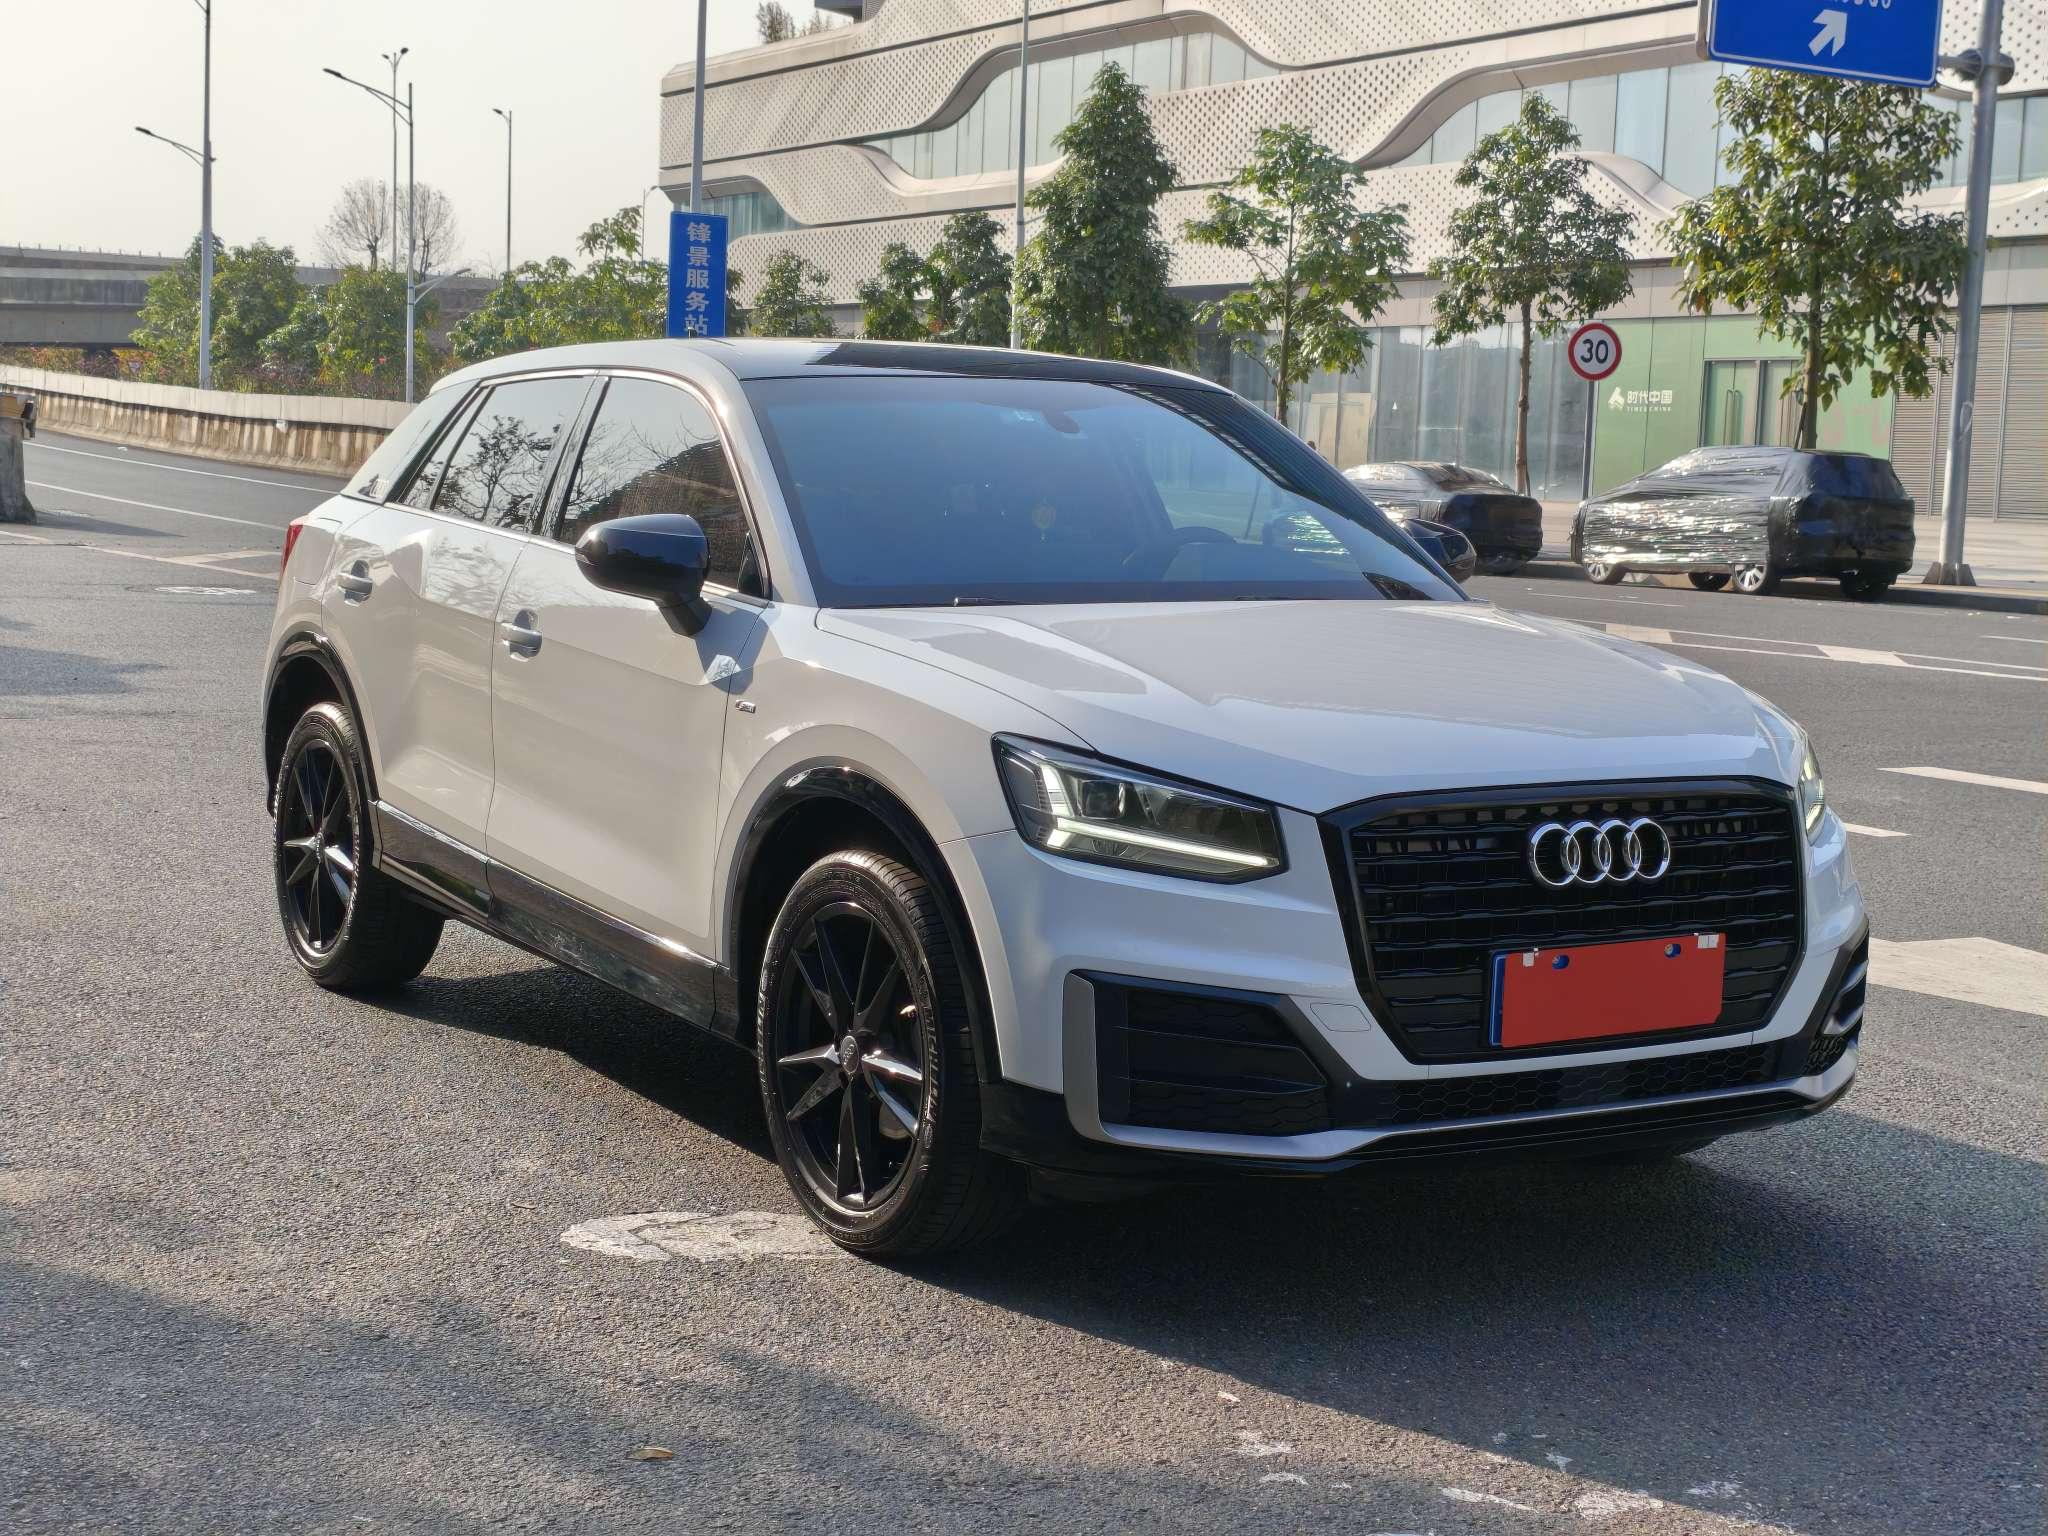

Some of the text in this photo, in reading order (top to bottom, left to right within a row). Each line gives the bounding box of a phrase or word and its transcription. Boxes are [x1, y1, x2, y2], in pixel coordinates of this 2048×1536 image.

[684, 222, 712, 336] 锋景服务站
[1580, 338, 1609, 364] 30
[1627, 390, 1673, 404] 时代中国
